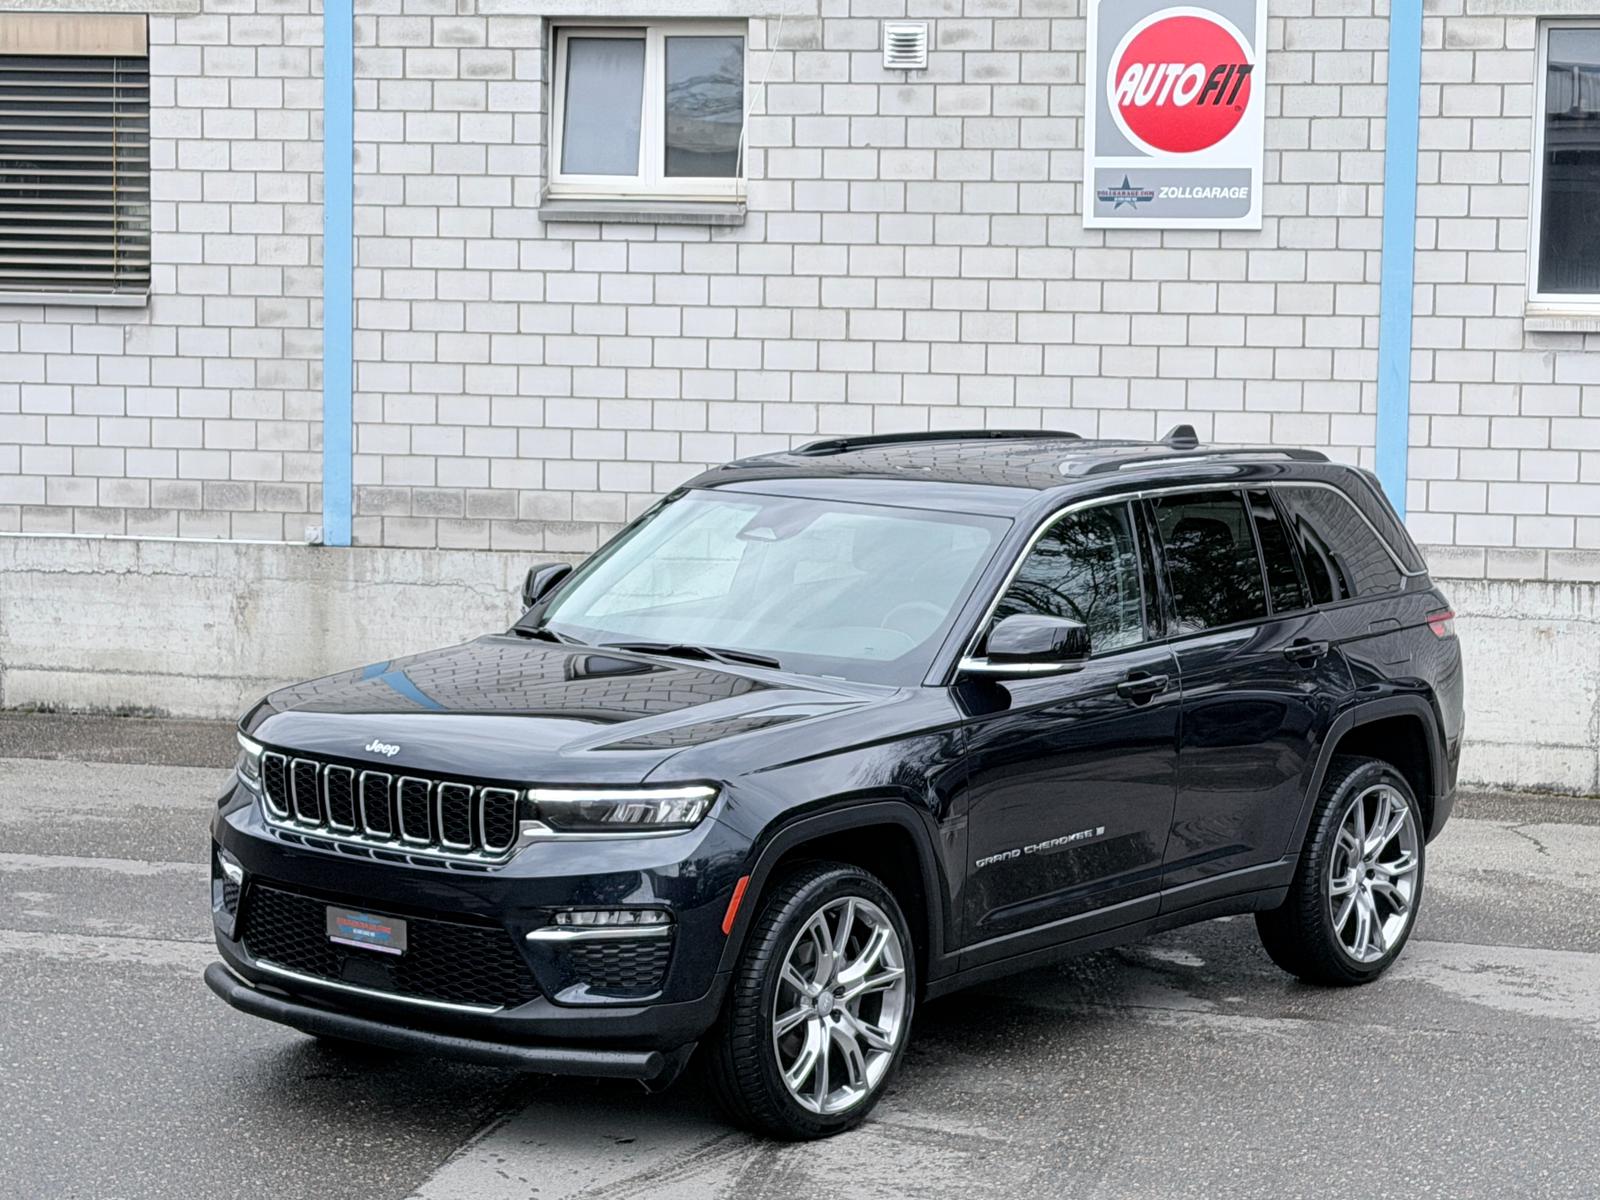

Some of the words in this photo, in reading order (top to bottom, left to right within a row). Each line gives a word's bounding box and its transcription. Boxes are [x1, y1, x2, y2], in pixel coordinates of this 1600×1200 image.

[1158, 186, 1249, 199] ZOLLGARAGE
[365, 739, 400, 757] Jeep
[976, 848, 1021, 868] GRAND
[1024, 829, 1093, 854] CHEROKEE
